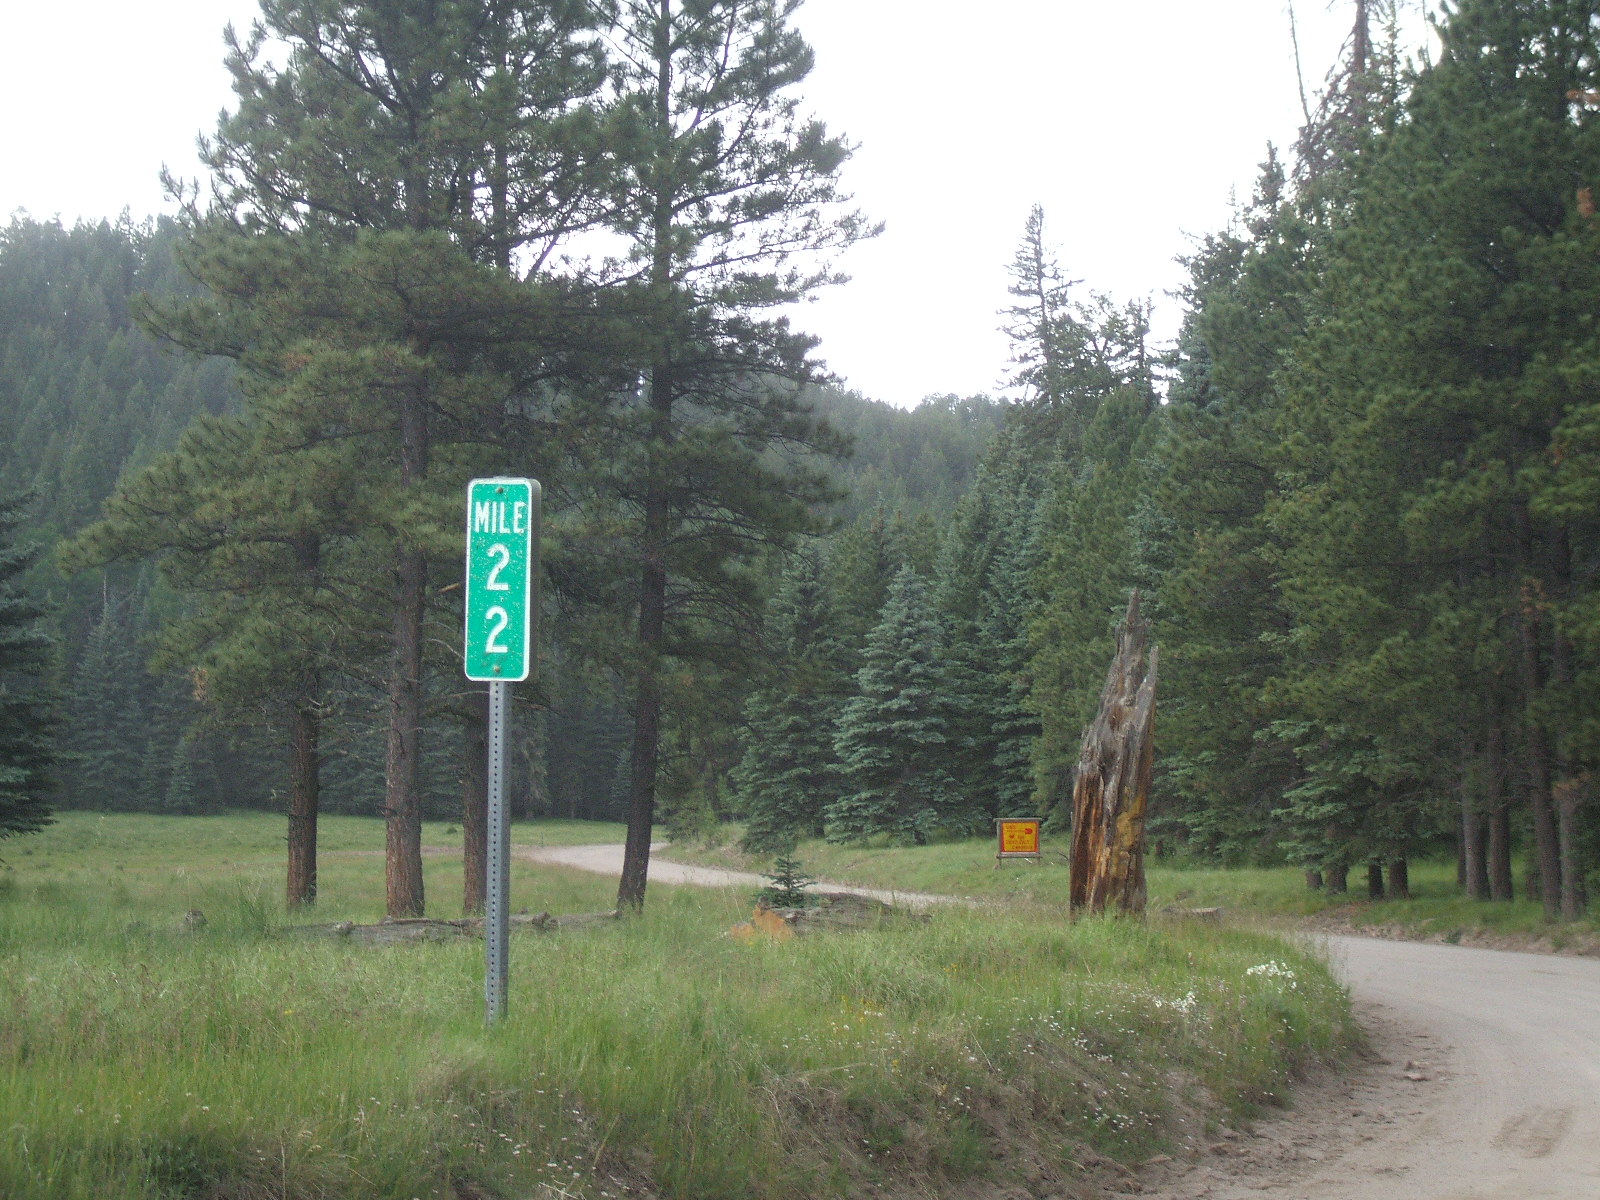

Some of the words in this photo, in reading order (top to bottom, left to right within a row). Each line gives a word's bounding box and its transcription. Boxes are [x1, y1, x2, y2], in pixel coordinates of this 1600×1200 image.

[474, 501, 526, 534] MILE
[486, 543, 510, 591] 2
[485, 605, 508, 653] 2
